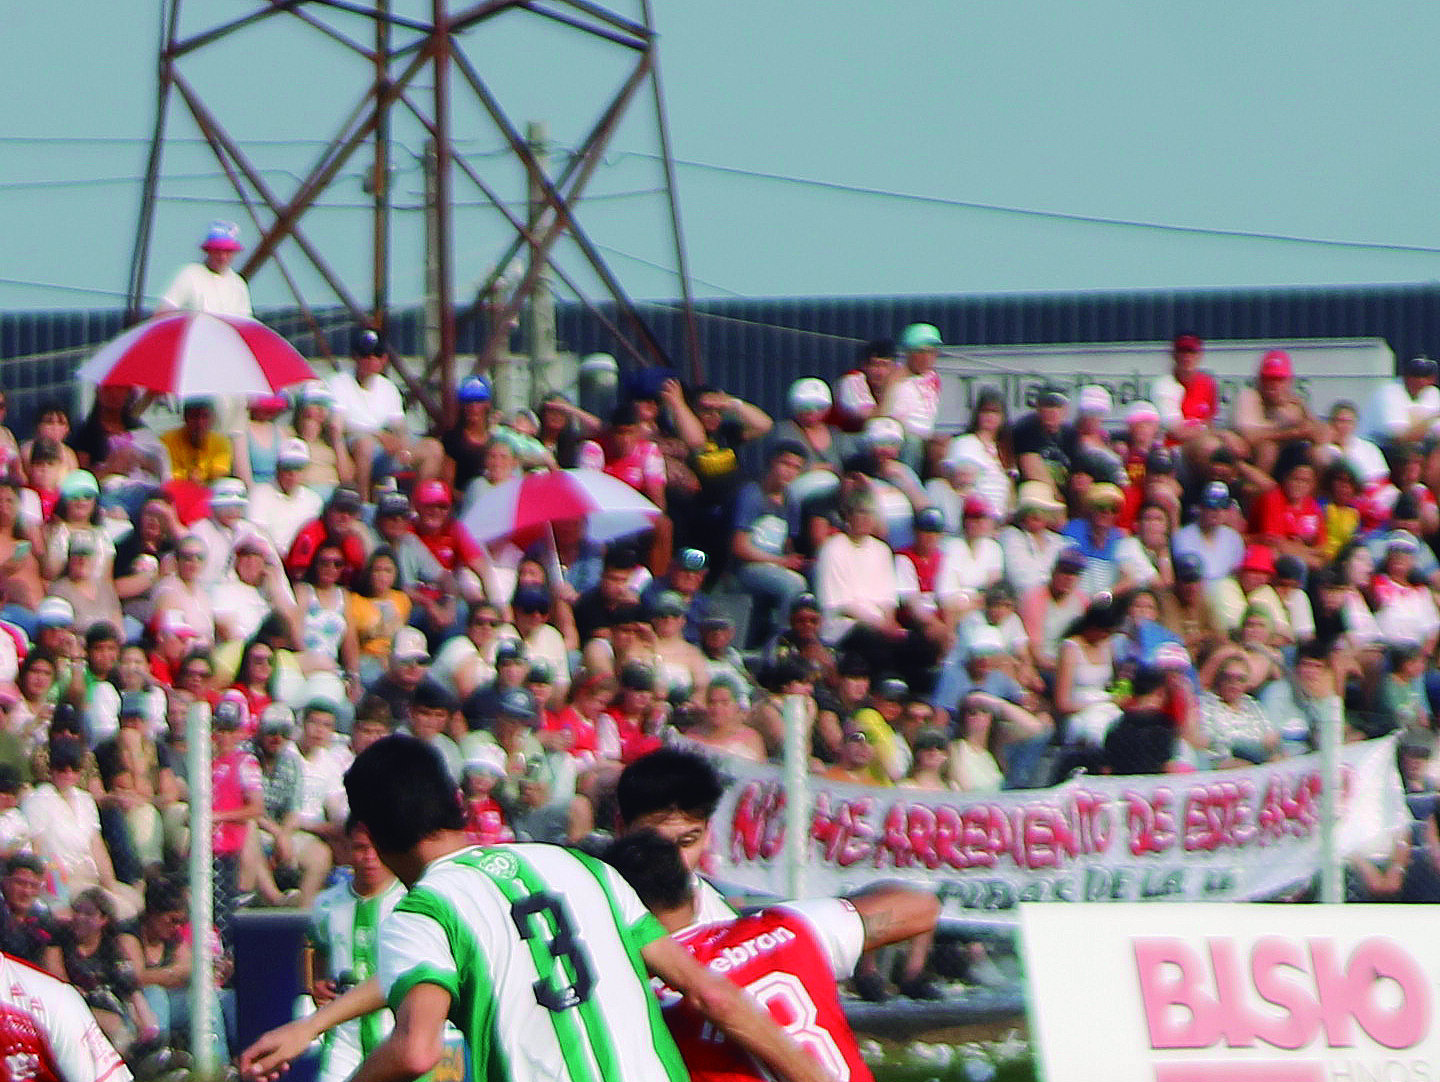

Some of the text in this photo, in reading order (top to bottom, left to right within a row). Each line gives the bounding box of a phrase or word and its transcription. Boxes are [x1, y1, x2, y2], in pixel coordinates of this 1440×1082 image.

[809, 790, 876, 867] ME
[1124, 785, 1176, 856] DE
[1184, 780, 1258, 852] ESTE
[511, 892, 598, 1012] 3
[709, 926, 797, 973] ebron
[1133, 935, 1431, 1050] BISIO
